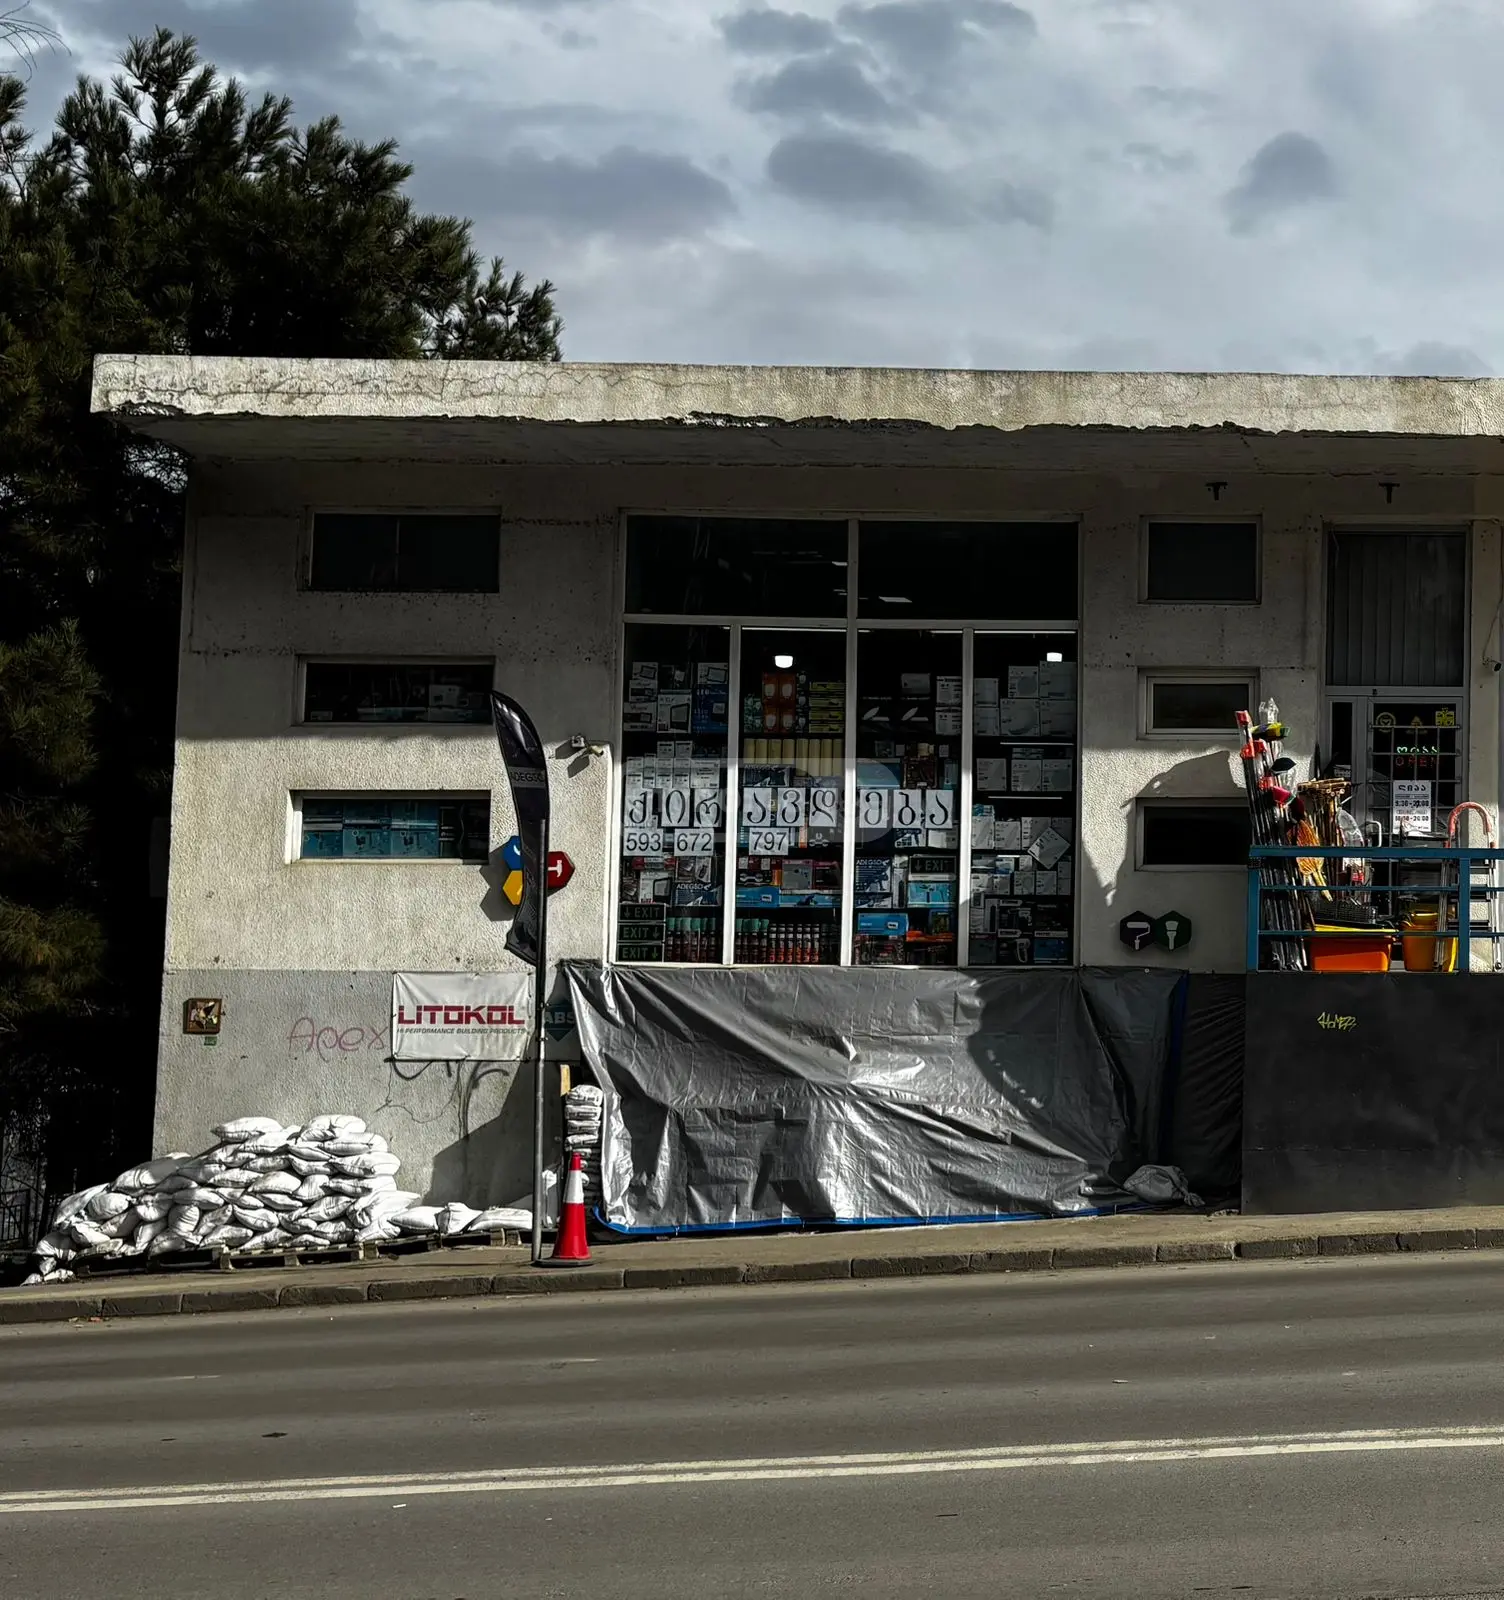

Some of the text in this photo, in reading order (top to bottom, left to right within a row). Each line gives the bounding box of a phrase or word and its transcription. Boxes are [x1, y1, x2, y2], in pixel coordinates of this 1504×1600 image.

[626, 831, 787, 852] 593 672 797
[924, 859, 952, 872] EXIT
[634, 906, 661, 918] EXIT
[622, 927, 650, 939] EXIT
[622, 947, 649, 959] EXIT
[398, 1005, 525, 1025] LITOKOL
[404, 1027, 455, 1035] PERFORMANCE
[456, 1027, 488, 1035] BUILDING
[489, 1027, 526, 1035] PRODUCTS
[287, 1016, 388, 1063] Apex
